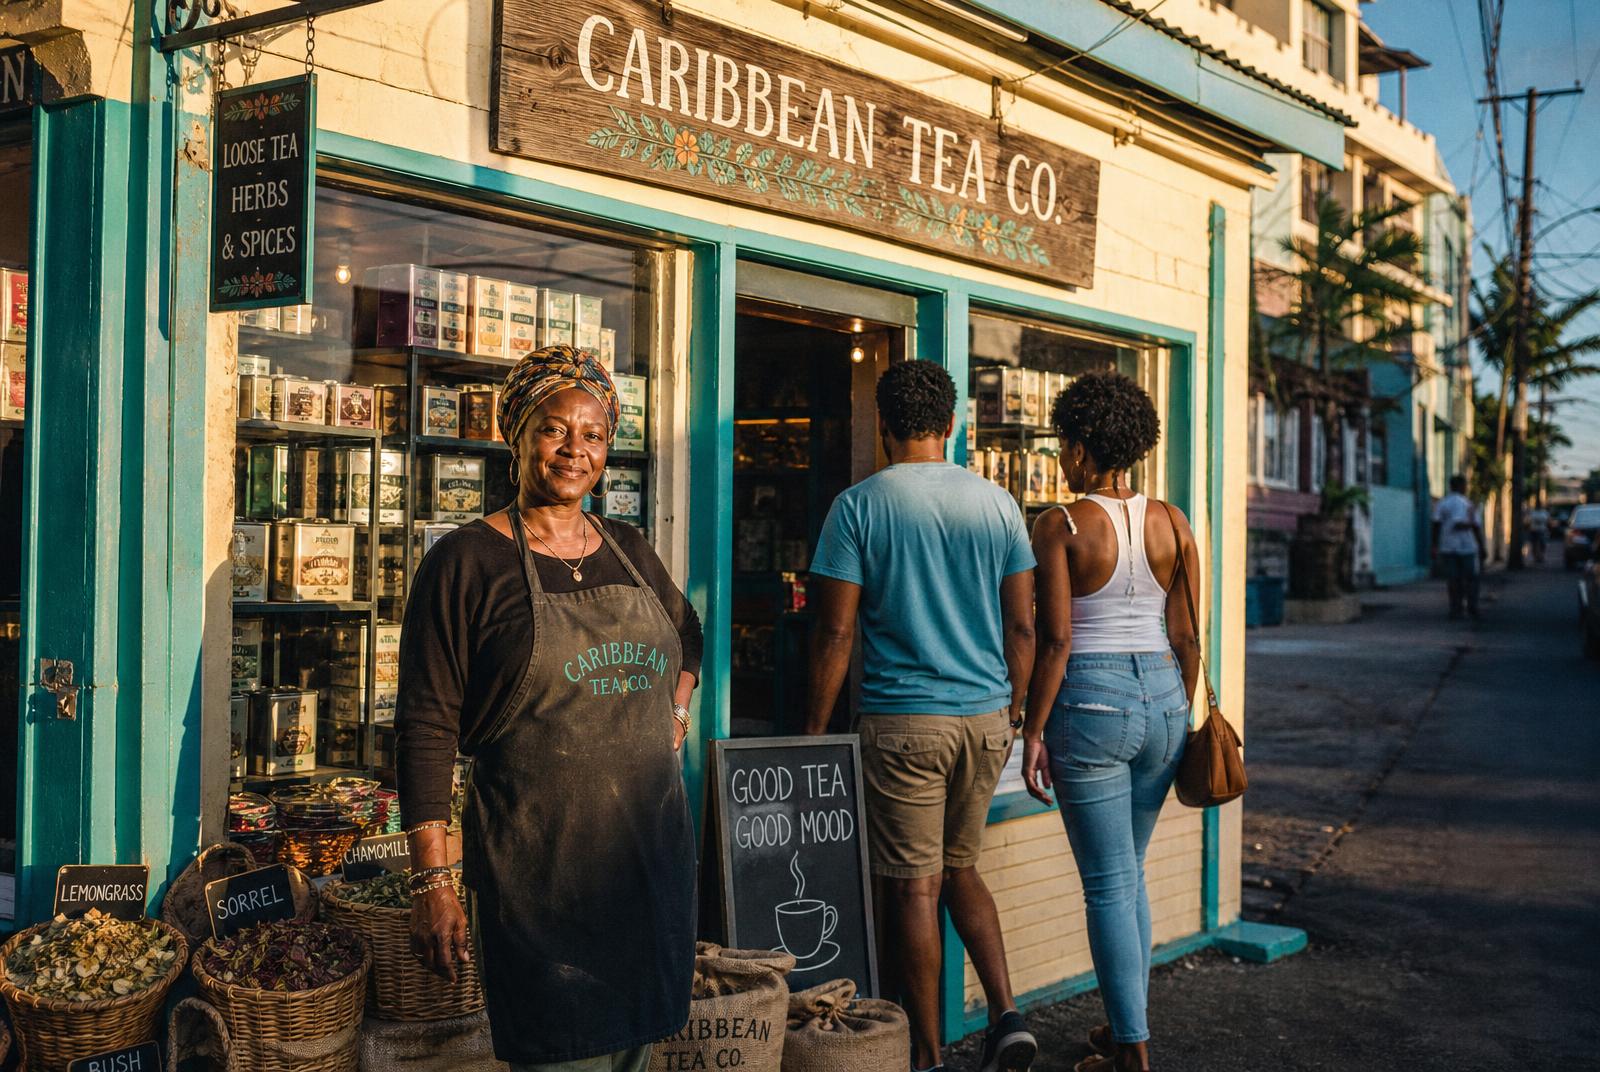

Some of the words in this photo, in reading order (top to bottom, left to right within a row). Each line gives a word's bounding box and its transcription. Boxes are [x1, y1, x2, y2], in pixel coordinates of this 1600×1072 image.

[577, 14, 877, 169] CARIBBEAN
[902, 115, 987, 204] TEA
[1006, 153, 1062, 225] CO.
[223, 138, 266, 169] LOOSE
[270, 132, 299, 162] TEA
[231, 179, 289, 213] HERBS
[222, 233, 235, 260] &
[240, 226, 296, 259] SPICES
[564, 641, 668, 683] CARIBBEAN
[589, 676, 622, 695] TEA
[628, 674, 652, 692] CO.
[732, 766, 793, 804] GOOD
[801, 763, 847, 799] TEA
[735, 813, 792, 850] GOOD
[800, 809, 854, 844] MOOD
[344, 840, 410, 864] CHAMOMILE
[61, 884, 144, 902] LEMONGRASS
[216, 884, 284, 920] SORREL
[663, 1050, 706, 1072] TEA
[716, 1048, 745, 1069] CO.
